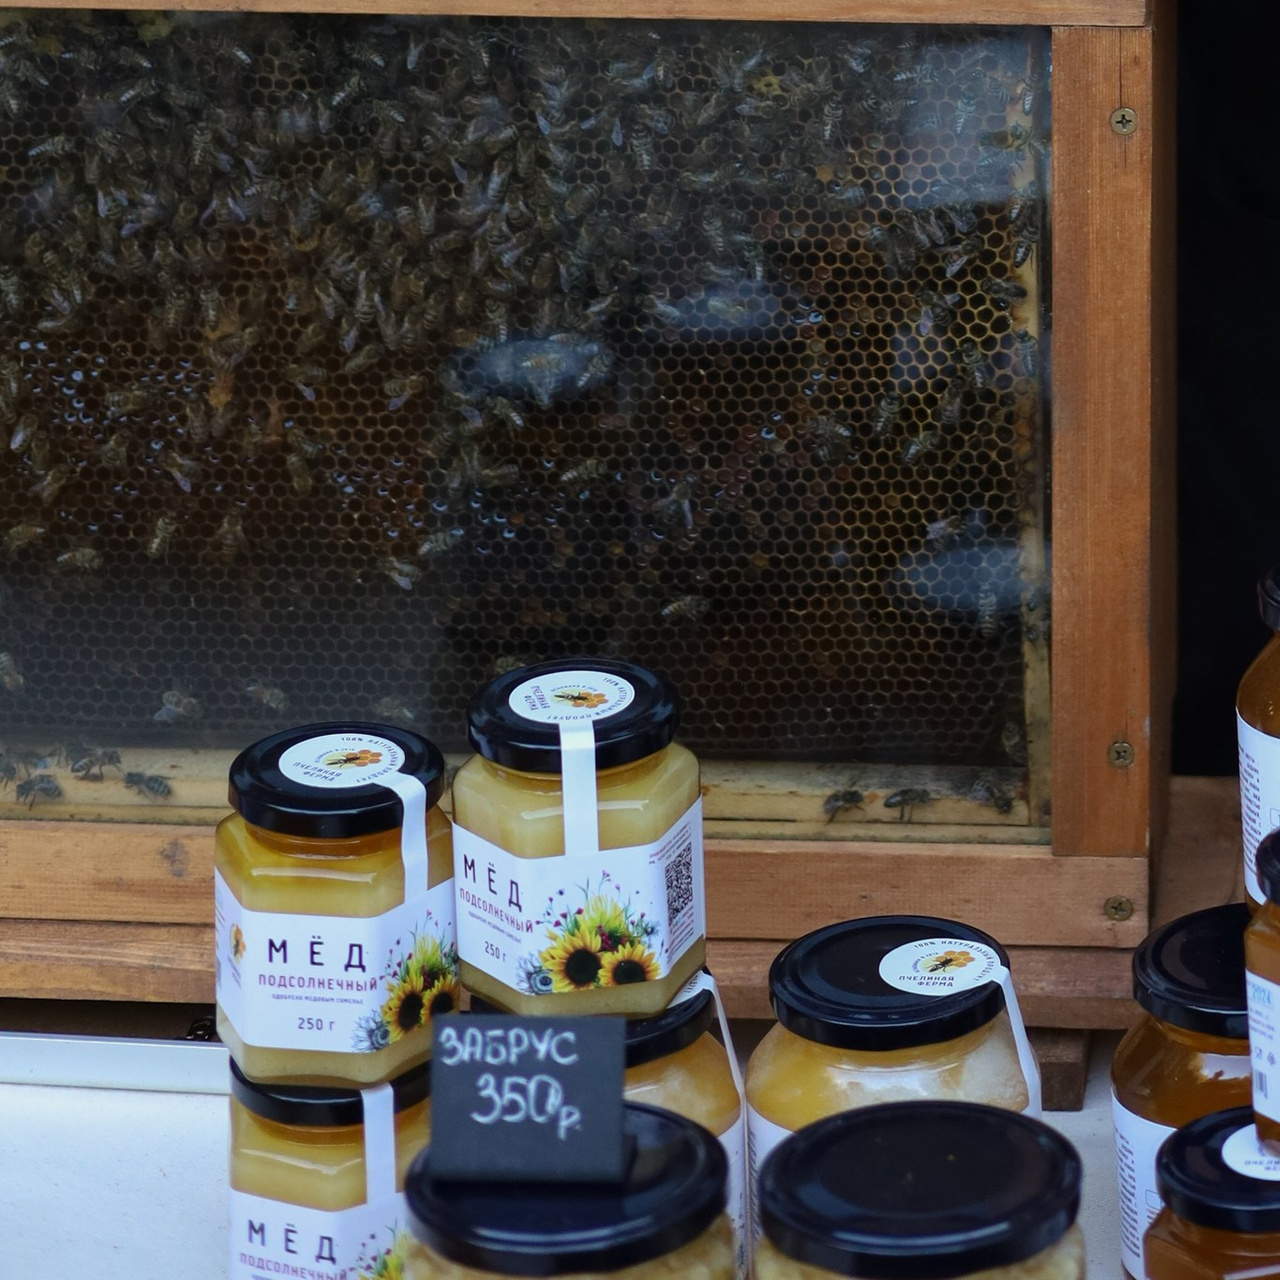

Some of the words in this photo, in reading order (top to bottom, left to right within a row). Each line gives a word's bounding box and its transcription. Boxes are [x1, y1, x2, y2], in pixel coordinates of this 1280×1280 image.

[292, 761, 342, 777] ПЧЕЛИНАЯ
[303, 771, 335, 782] ФЕРМА
[463, 853, 523, 913] МЁД
[460, 887, 534, 933] ПОДСОЛНЕЧНЫЙ
[268, 935, 366, 973] МЁД
[485, 941, 500, 959] 250
[258, 973, 378, 991] ПОДСОЛНЕЧНЫЙ
[298, 1017, 324, 1031] 250
[439, 1026, 580, 1067] ЗАБРУС
[248, 1219, 336, 1264] МЁД
